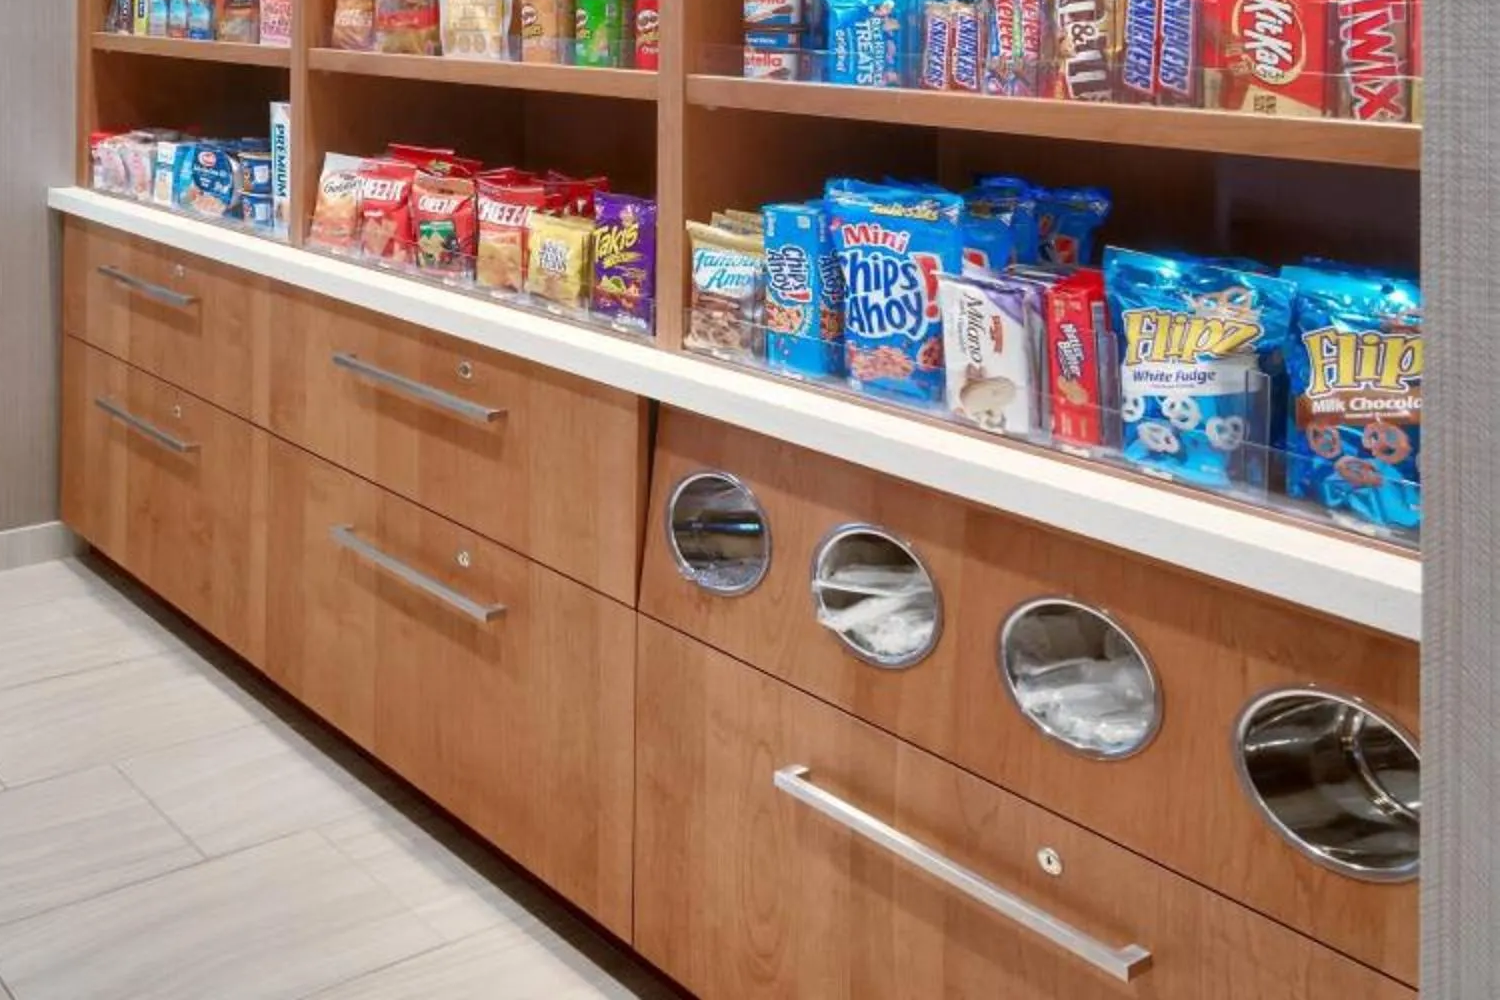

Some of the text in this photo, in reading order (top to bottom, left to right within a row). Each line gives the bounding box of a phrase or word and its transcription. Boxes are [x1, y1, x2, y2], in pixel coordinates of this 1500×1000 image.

[855, 21, 873, 85] TREATS
[928, 17, 948, 88] SNICKERS
[955, 15, 979, 86] SNICKERS
[275, 123, 287, 198] PREMIUM
[592, 221, 640, 263] Takis
[782, 246, 807, 291] Chips
[844, 225, 908, 252] Mini
[964, 292, 986, 364] Milano
[1125, 309, 1262, 366] Flipz
[1133, 369, 1217, 383] White Fudge
[1303, 327, 1422, 398] Flip
[1312, 397, 1422, 413] Milk Chocol
